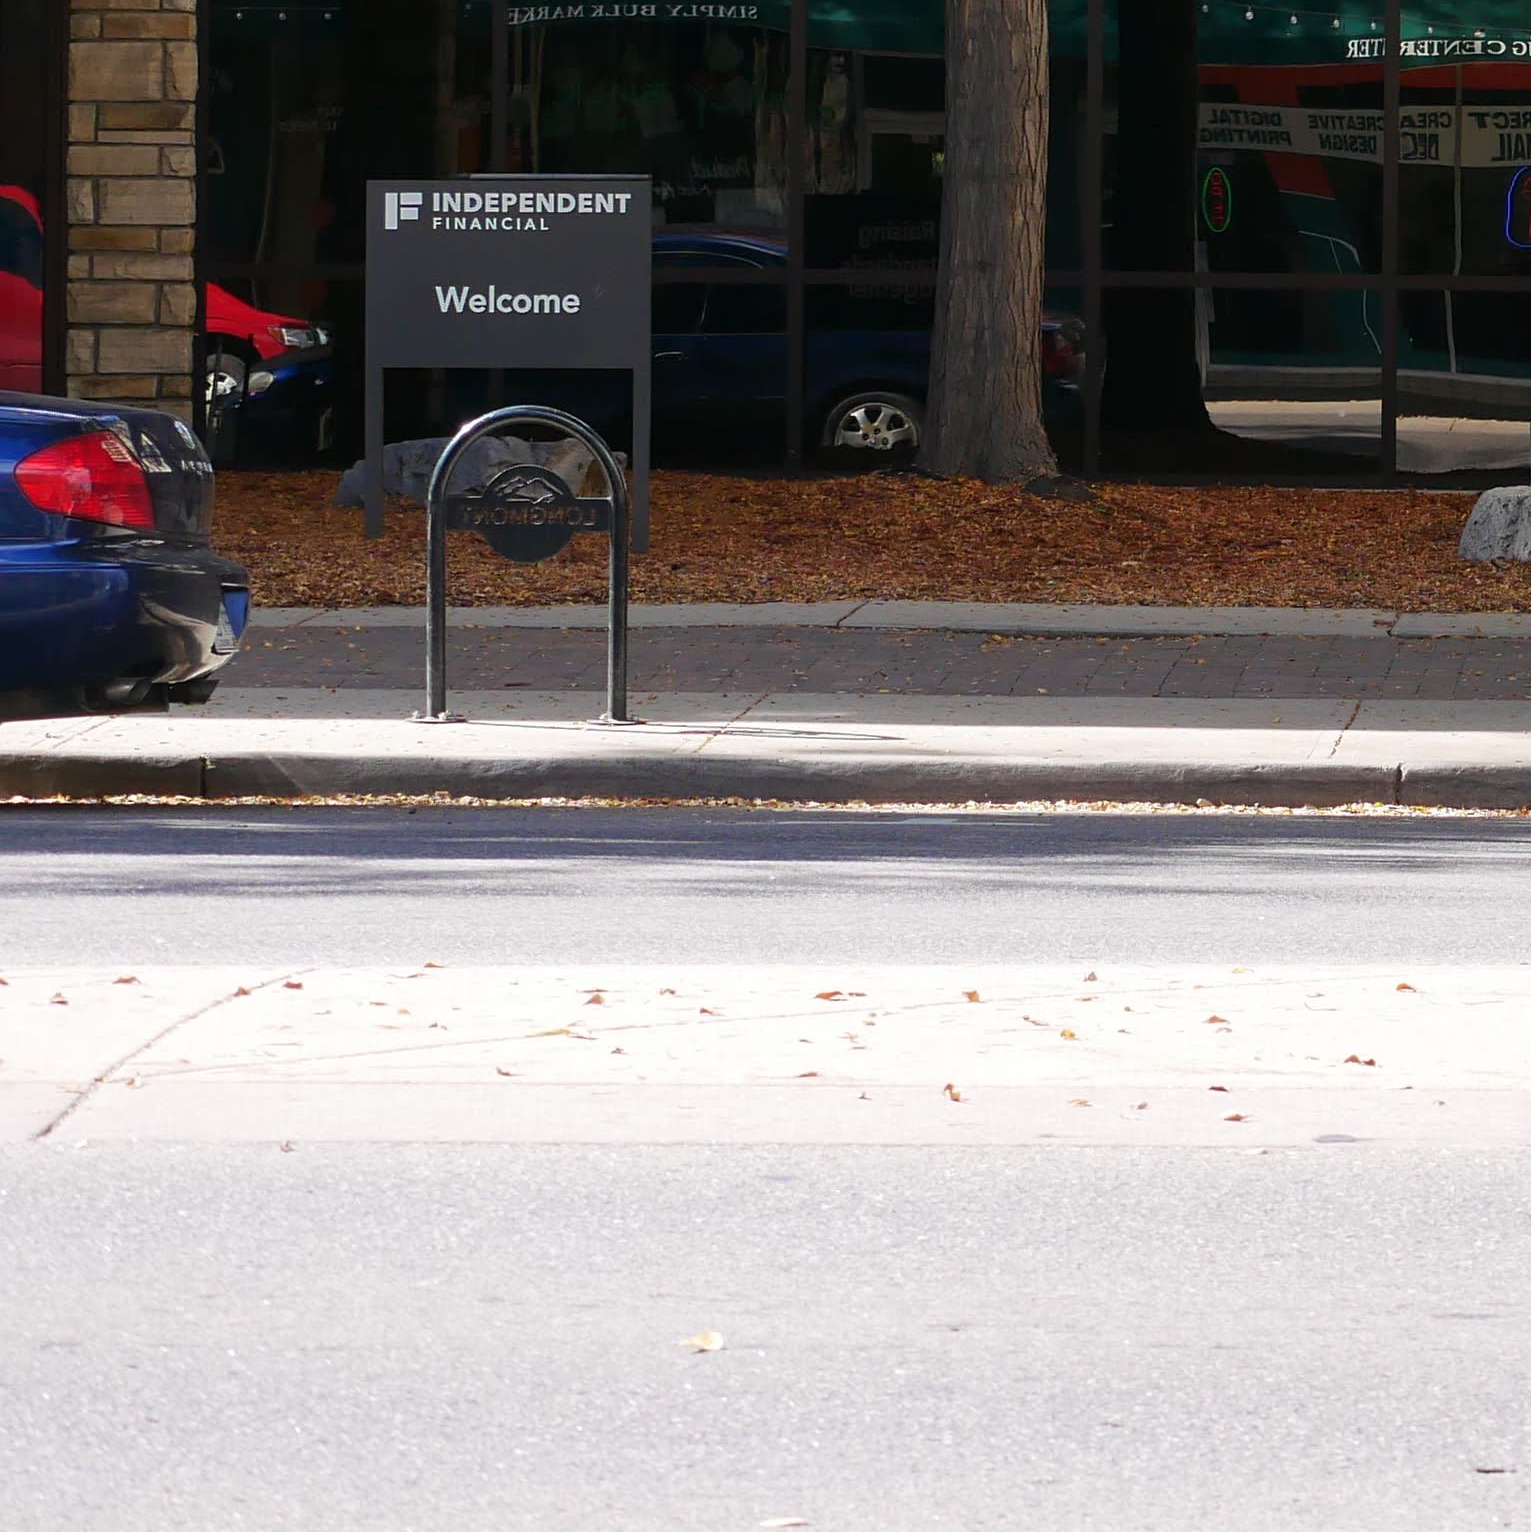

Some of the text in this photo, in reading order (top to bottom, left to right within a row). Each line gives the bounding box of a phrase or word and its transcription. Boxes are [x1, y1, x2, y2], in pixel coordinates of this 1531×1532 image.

[432, 192, 631, 214] INDEPENDENT
[432, 217, 550, 231] FINANCIAL
[435, 285, 581, 313] Welcome
